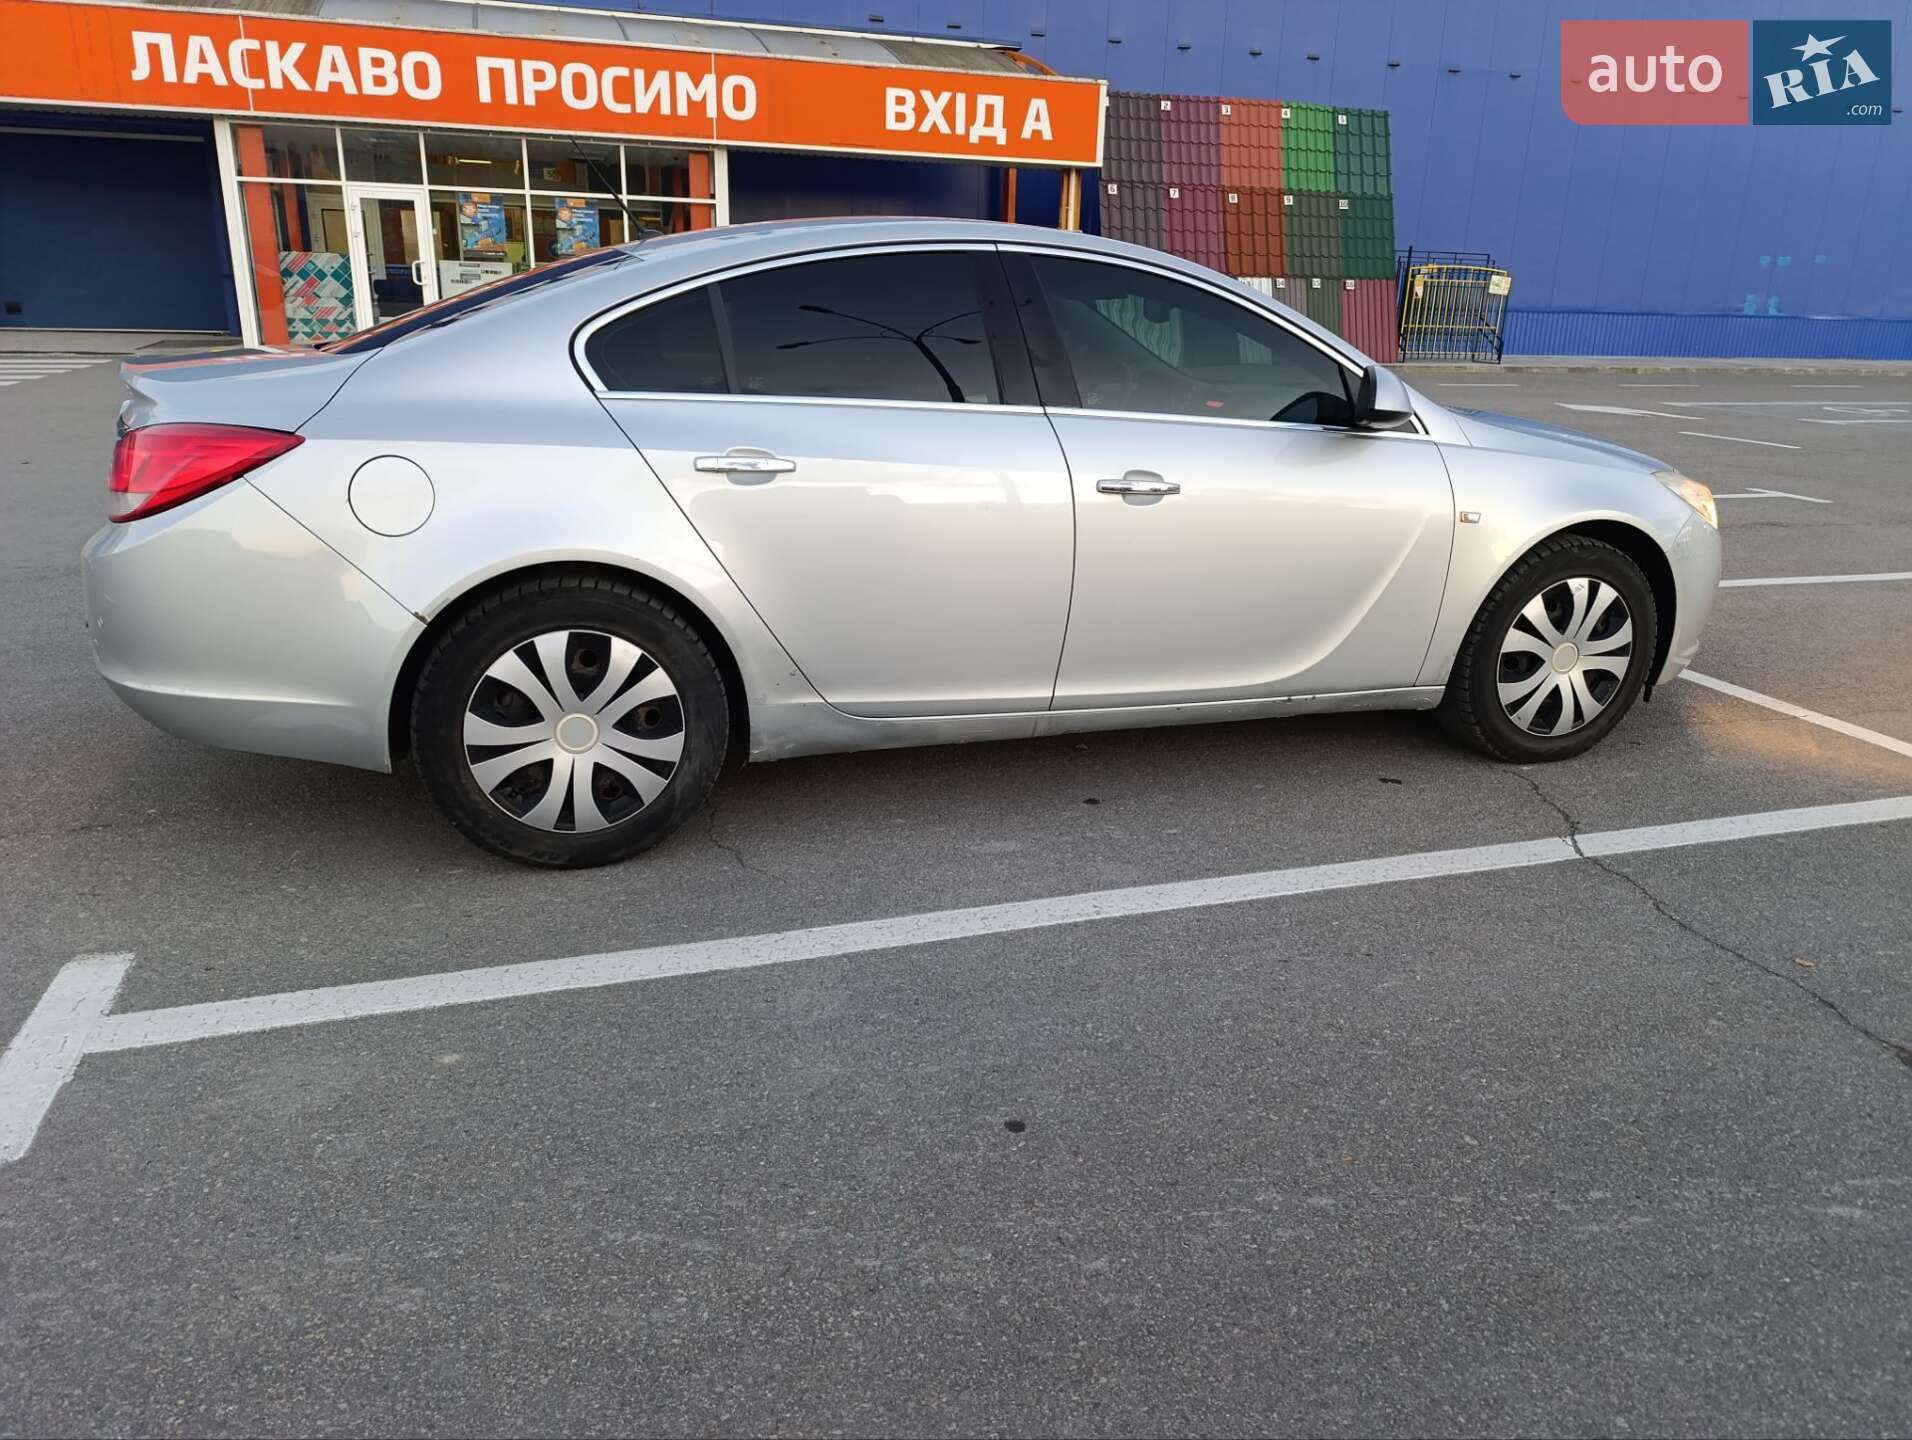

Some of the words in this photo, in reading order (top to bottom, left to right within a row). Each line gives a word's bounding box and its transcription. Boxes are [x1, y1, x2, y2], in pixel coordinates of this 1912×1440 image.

[131, 30, 442, 101] ЛАСКАВО
[475, 56, 757, 122] ПРОСИМО
[885, 87, 1007, 146] ВХІД
[1021, 98, 1053, 141] А
